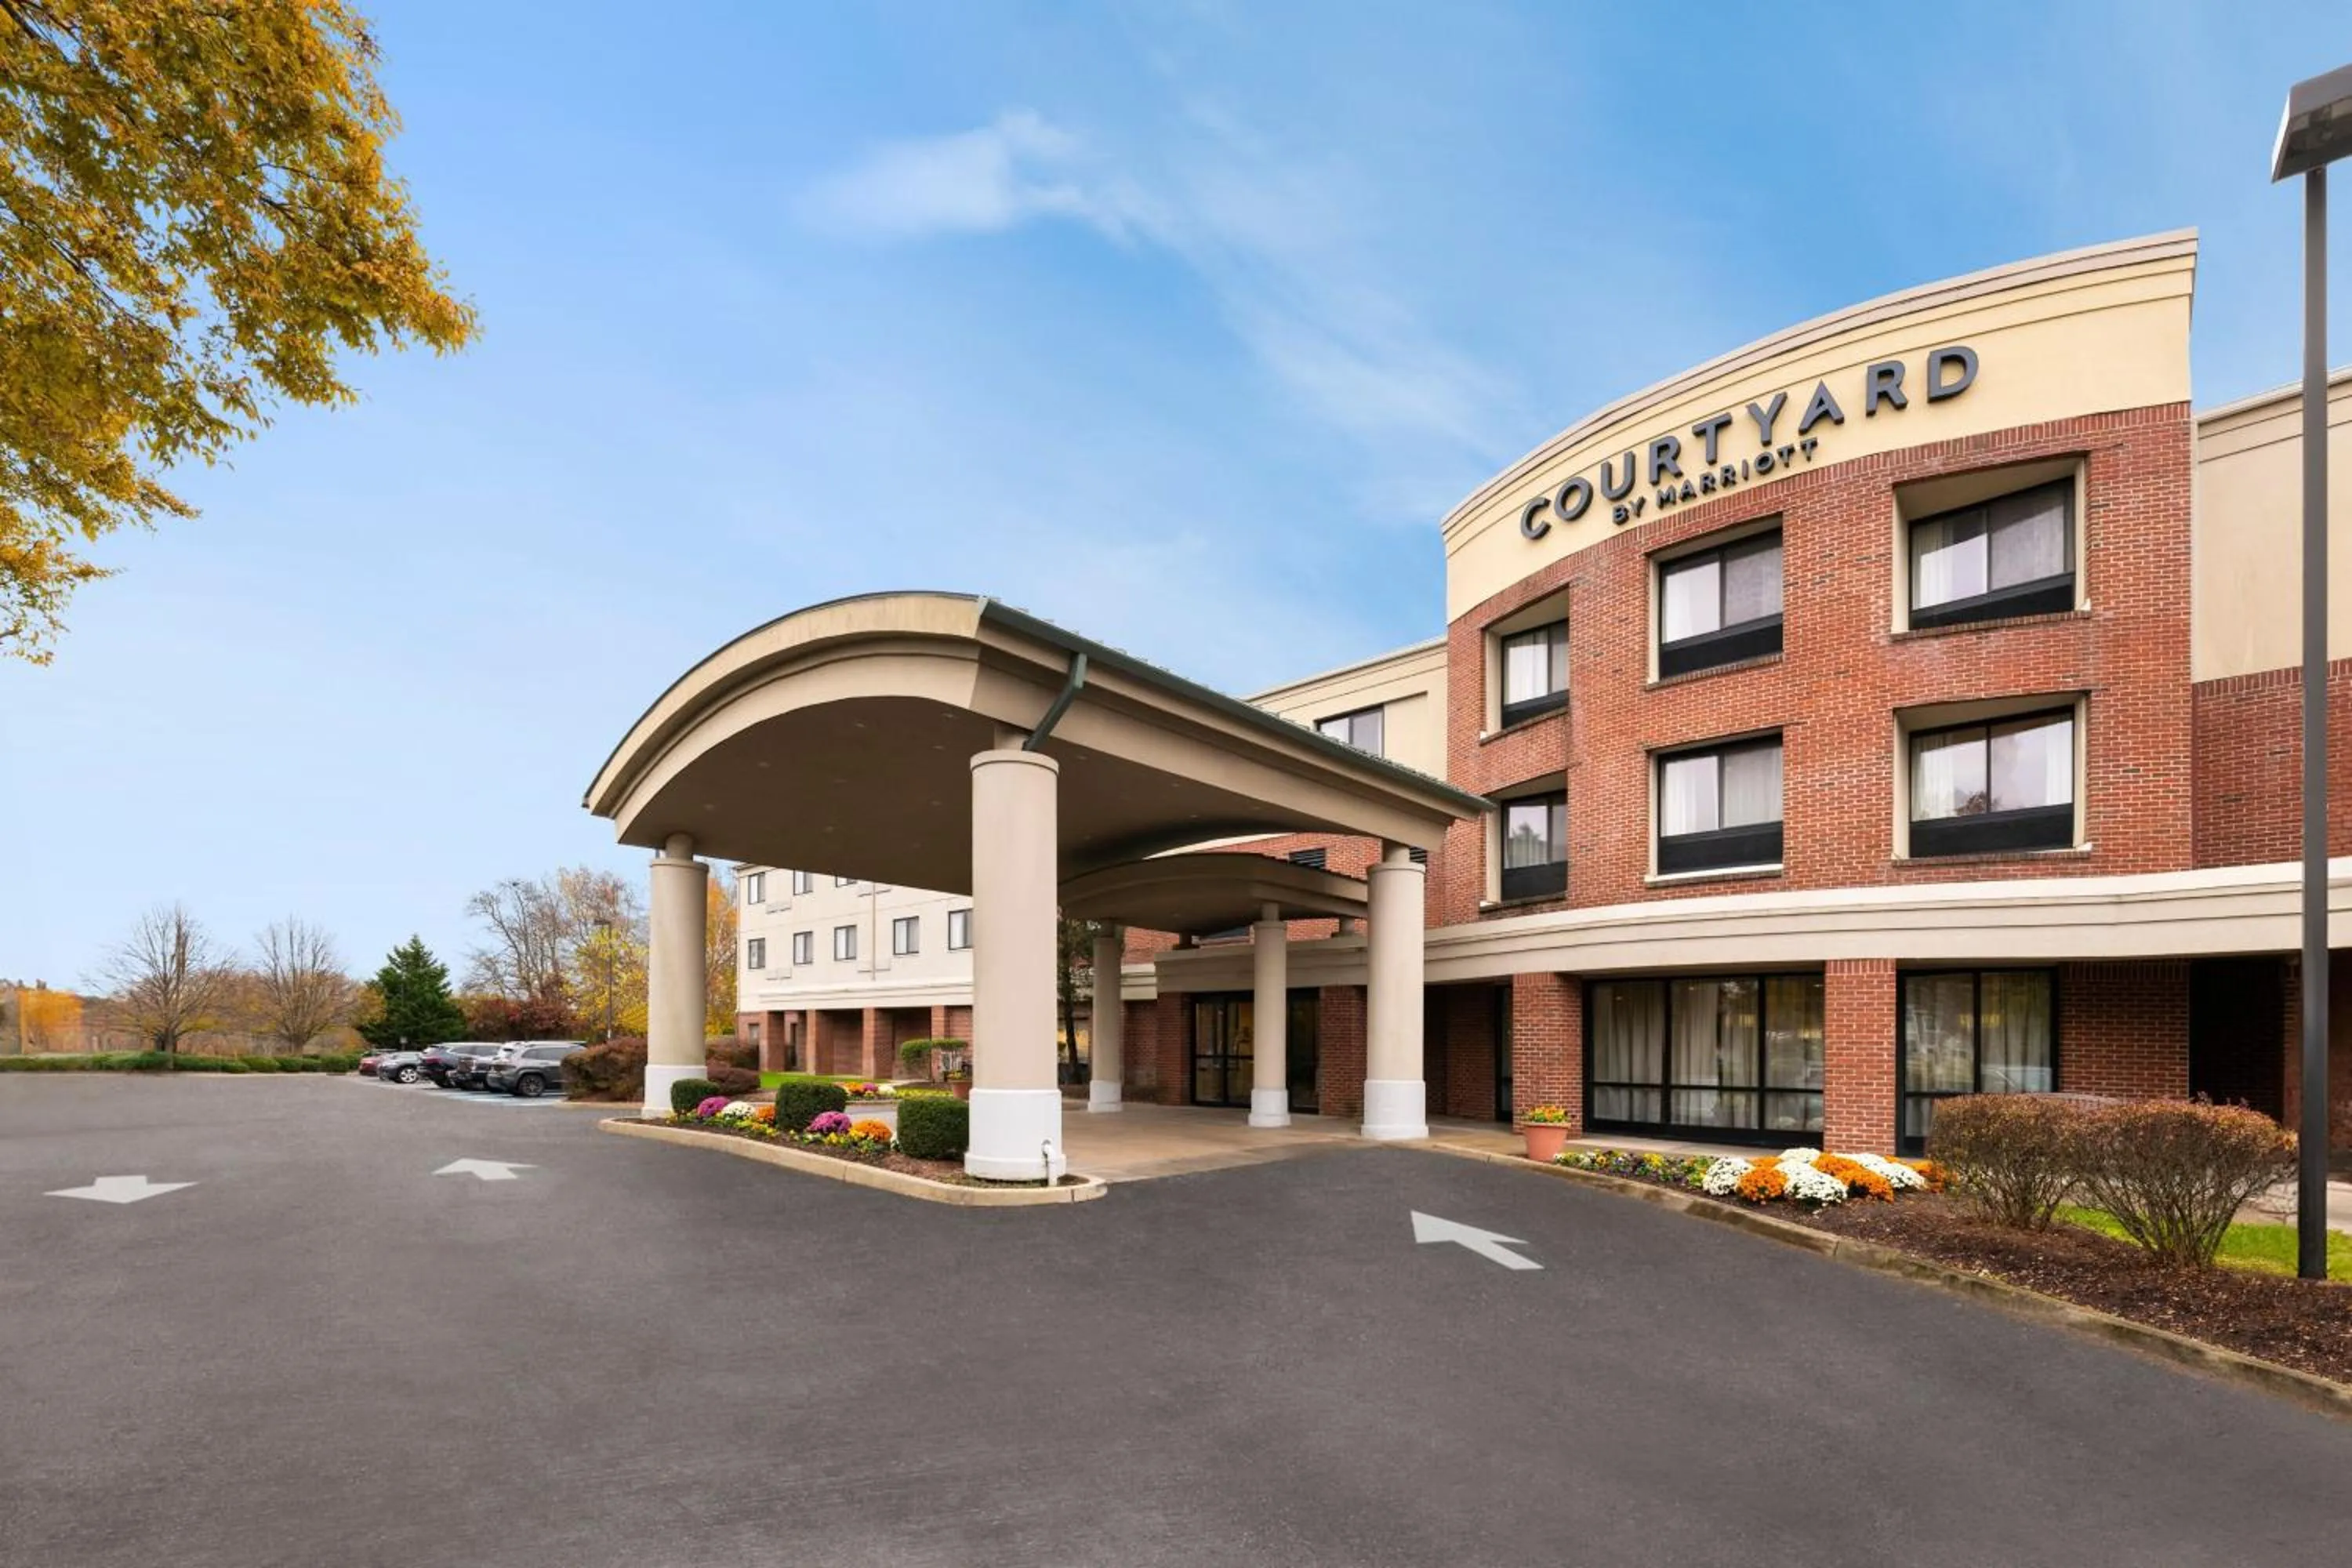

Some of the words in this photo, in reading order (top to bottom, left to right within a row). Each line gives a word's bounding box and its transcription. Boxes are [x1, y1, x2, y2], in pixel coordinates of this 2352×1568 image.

[1520, 346, 1980, 540] COURTYARD
[1613, 496, 1646, 526] BY
[1657, 437, 1818, 509] MARRIOTT
